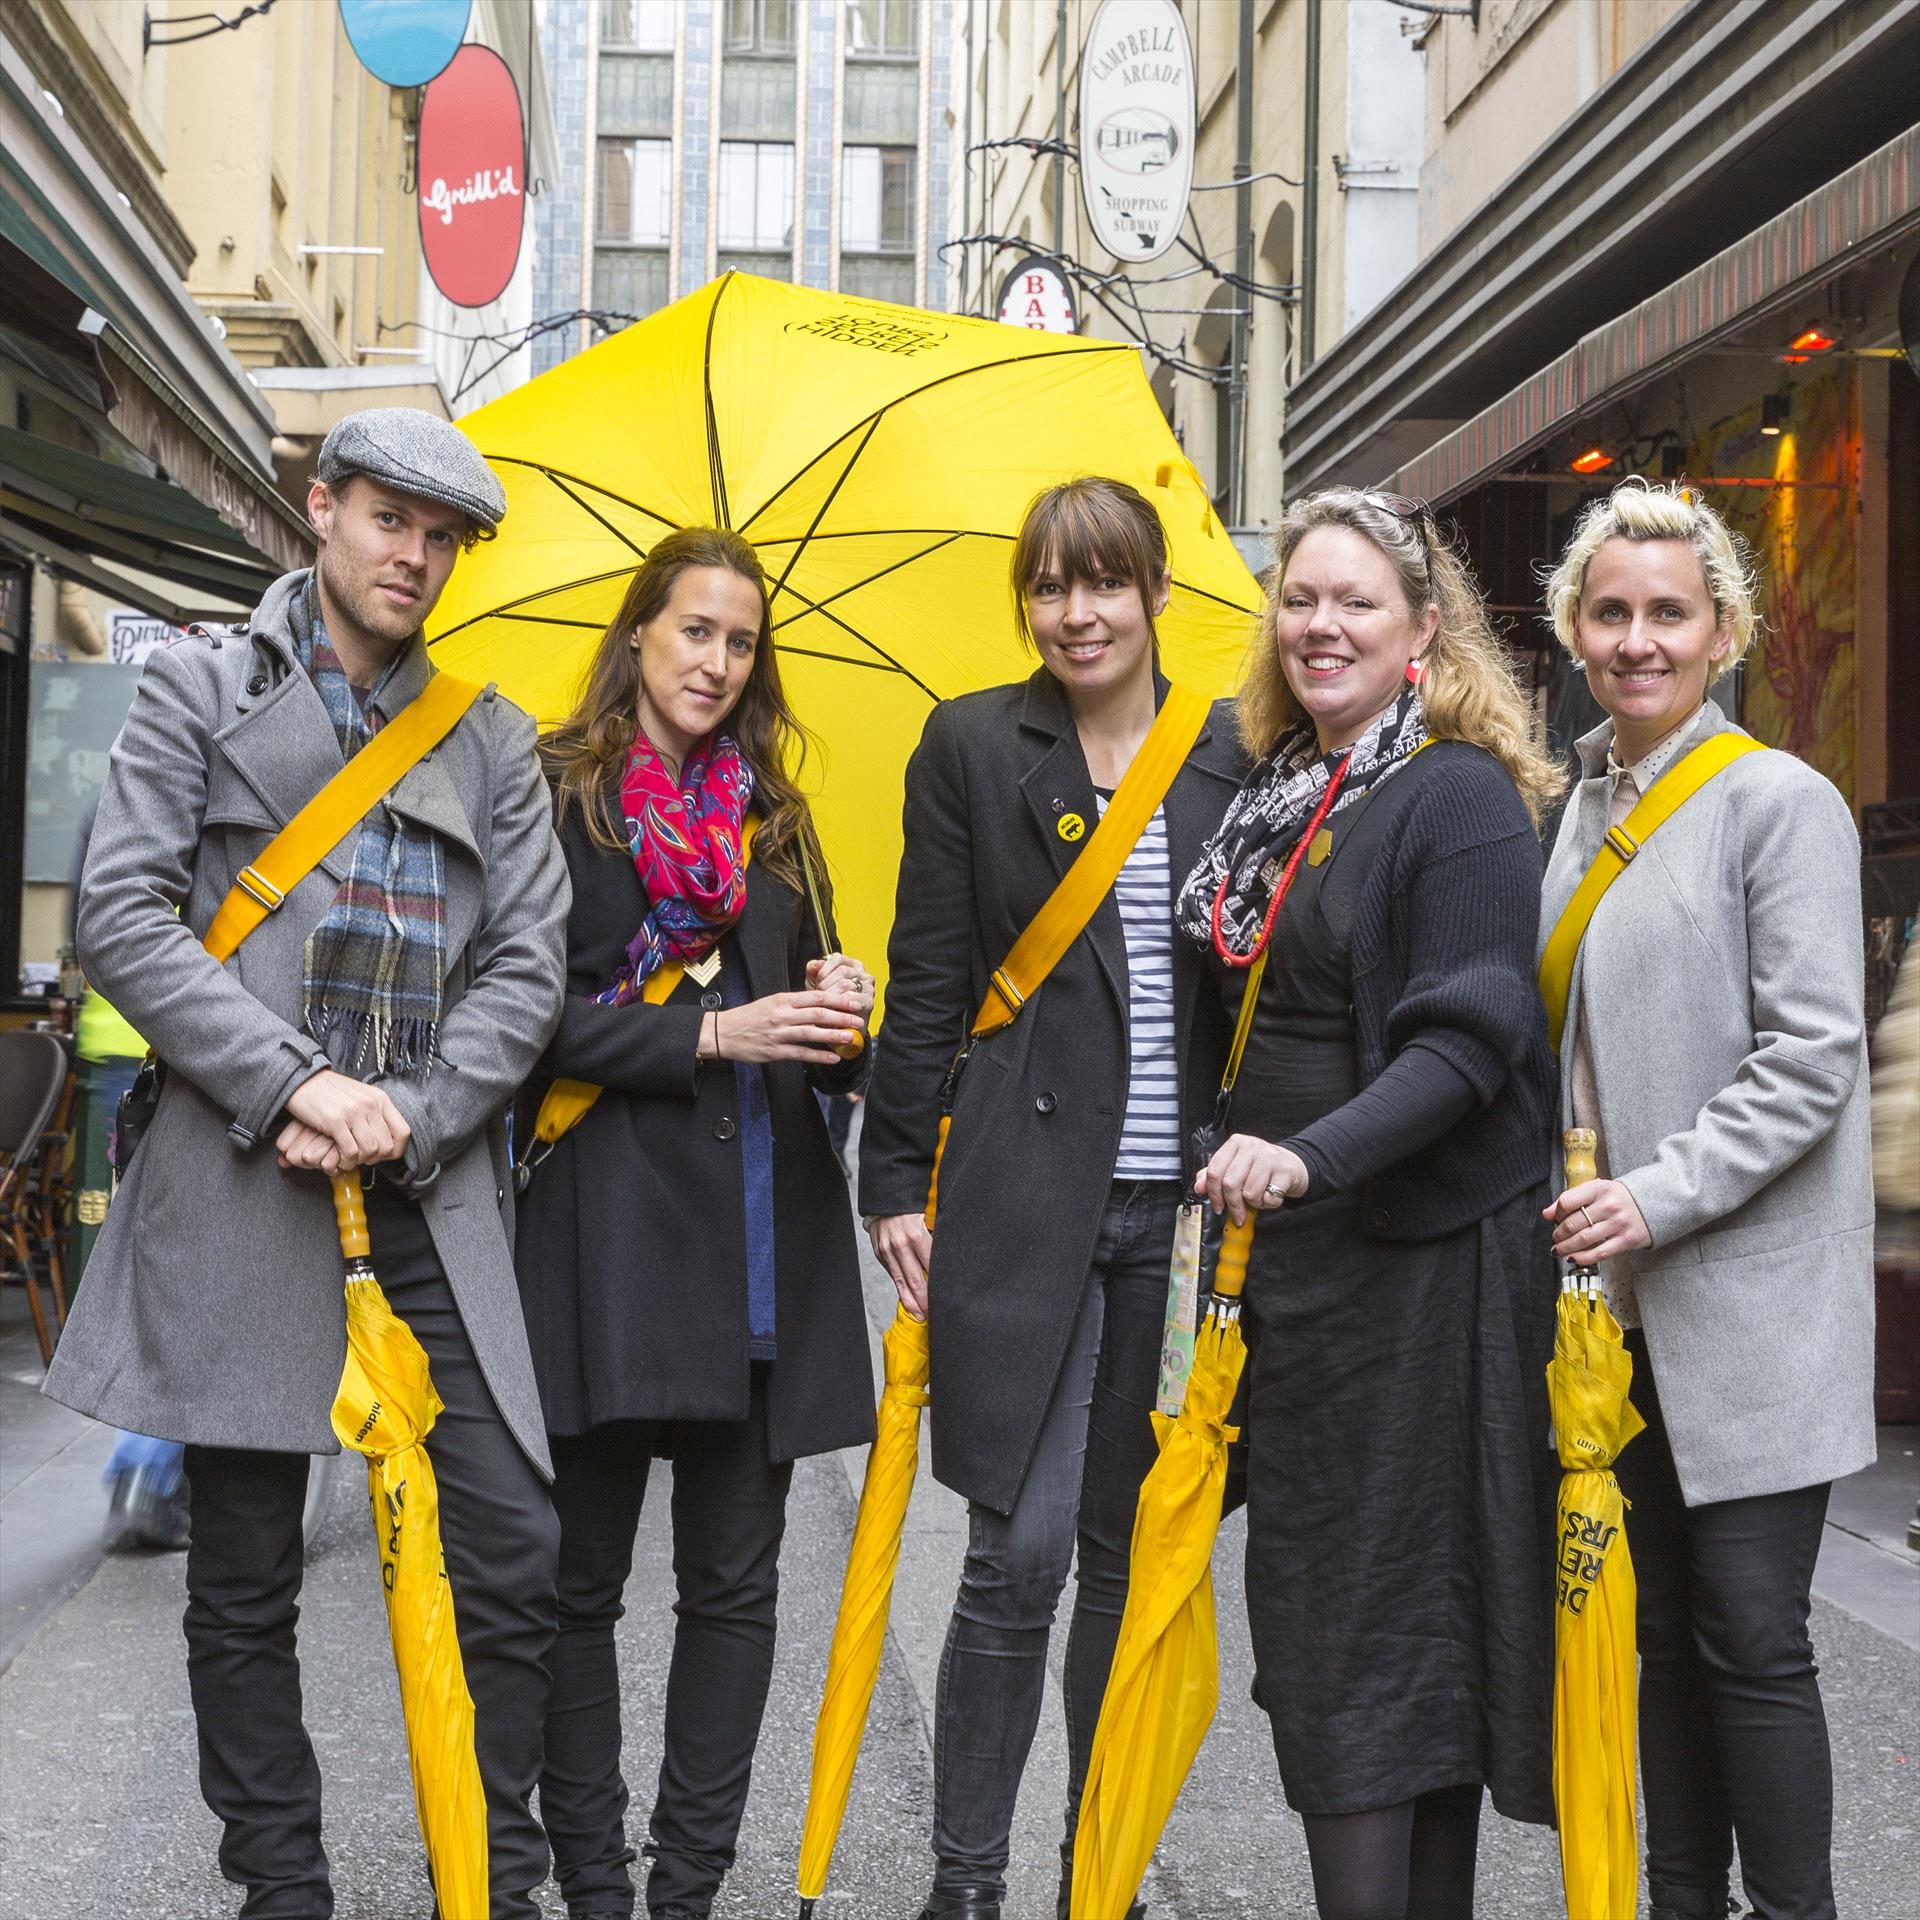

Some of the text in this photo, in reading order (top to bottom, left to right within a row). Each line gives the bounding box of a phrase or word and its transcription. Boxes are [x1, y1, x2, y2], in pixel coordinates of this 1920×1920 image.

[1092, 26, 1175, 80] CAMPBELL
[1122, 63, 1184, 86] ARCADE
[423, 165, 520, 225] Grill'd
[1106, 198, 1168, 211] SHOPPING
[1113, 219, 1160, 232] SUBWAY
